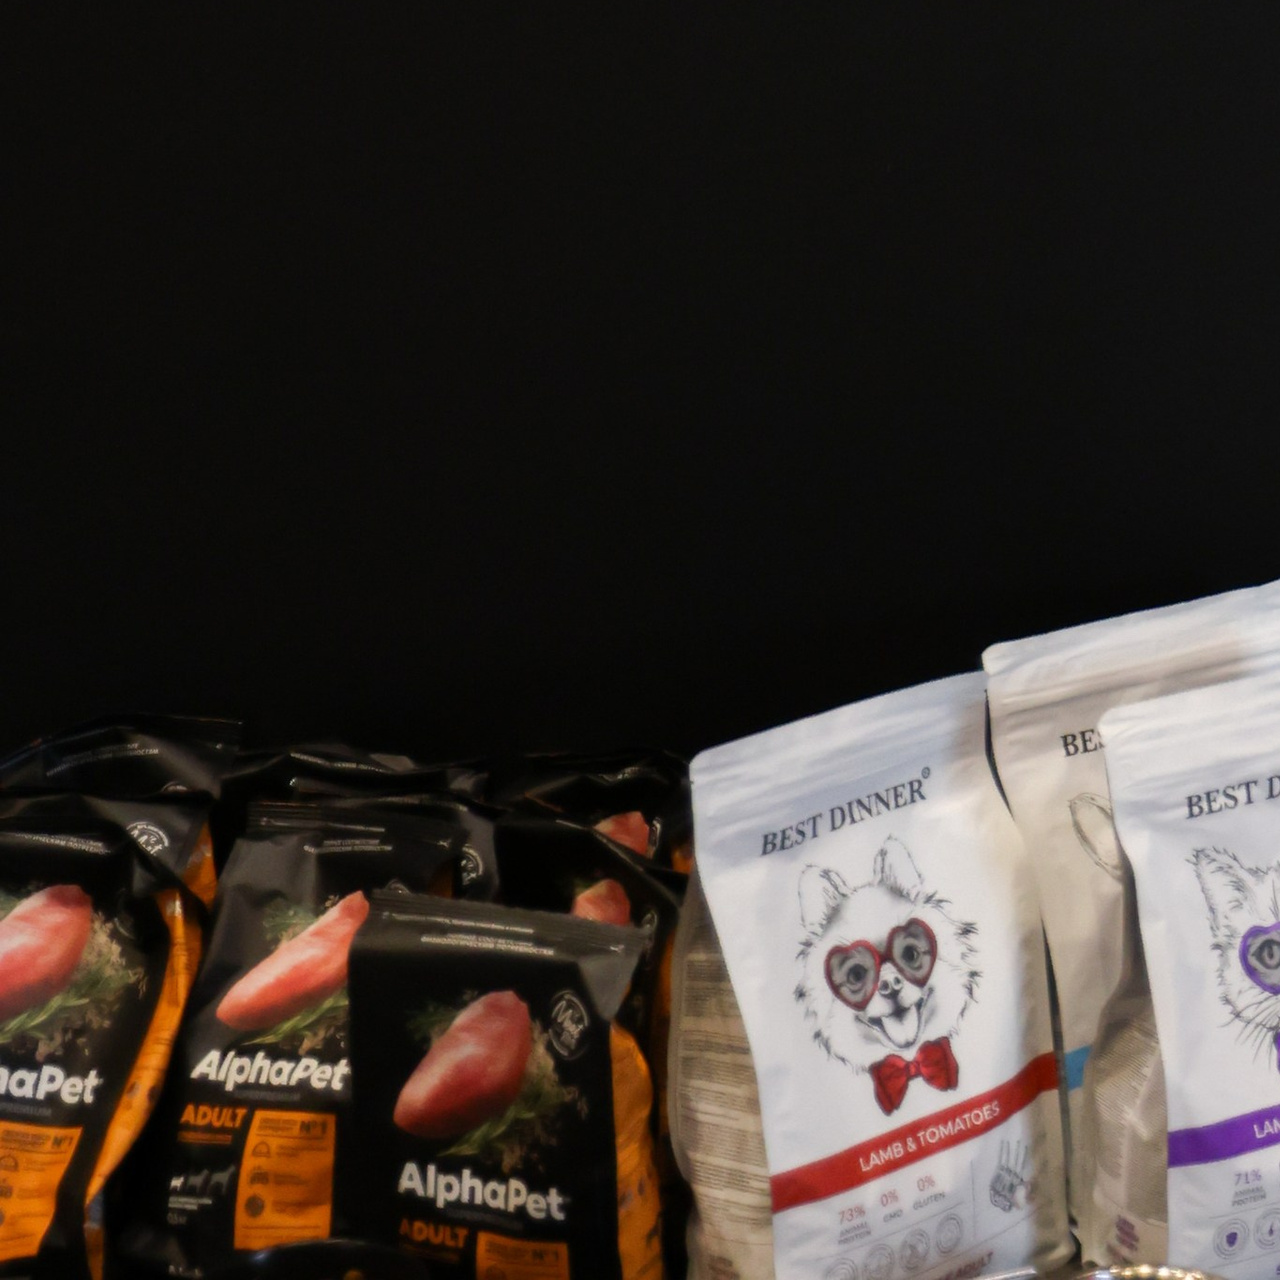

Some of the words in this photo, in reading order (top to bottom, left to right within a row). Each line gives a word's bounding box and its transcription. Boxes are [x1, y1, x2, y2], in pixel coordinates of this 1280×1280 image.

[760, 813, 823, 856] BEST
[829, 779, 926, 832] DINNER
[1186, 781, 1258, 819] BEST
[190, 1049, 349, 1091] AlphaPet
[180, 1104, 248, 1127] ADULT
[860, 1145, 904, 1172] LAMB
[907, 1137, 917, 1153] &
[918, 1101, 1000, 1147] TOMATOES
[398, 1162, 566, 1221] AlphaPet
[1234, 1170, 1262, 1185] 71%
[838, 1204, 866, 1224] 73%
[880, 1189, 899, 1207] 0%
[917, 1174, 936, 1191] 0%
[400, 1219, 469, 1248] ADULT
